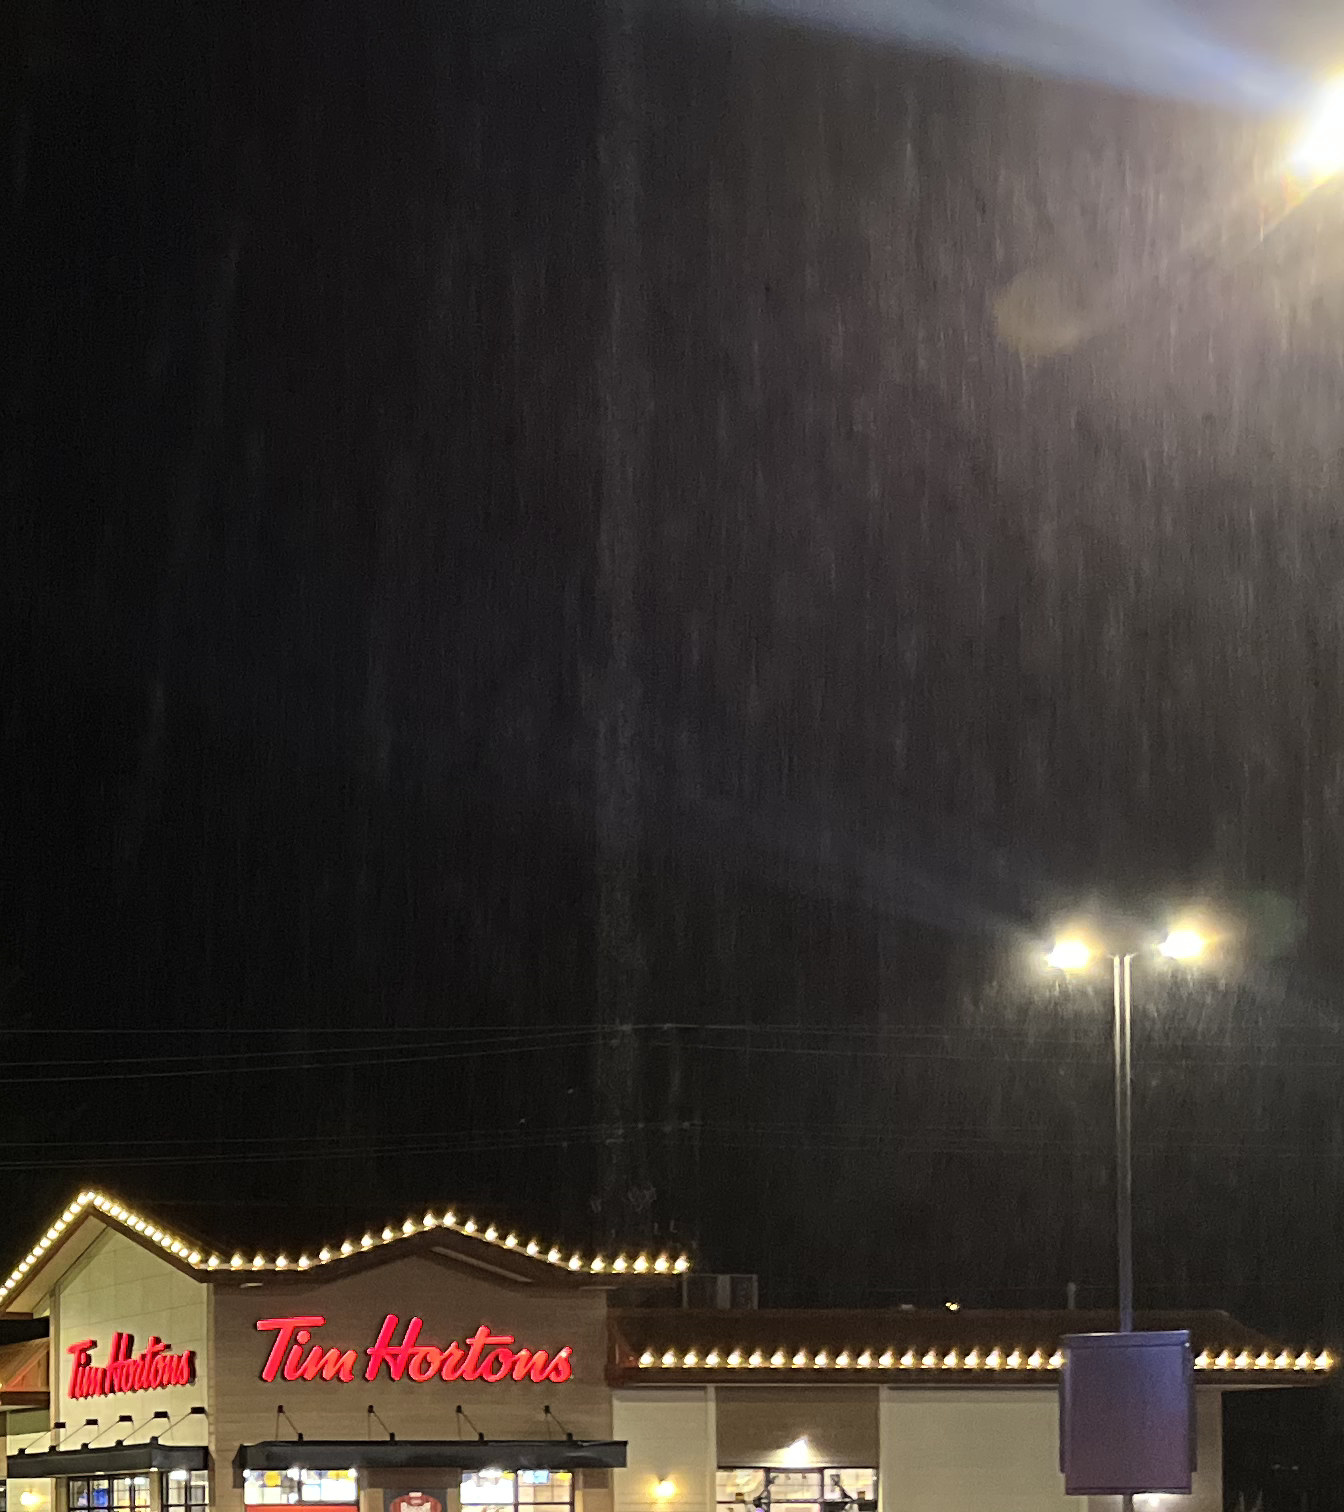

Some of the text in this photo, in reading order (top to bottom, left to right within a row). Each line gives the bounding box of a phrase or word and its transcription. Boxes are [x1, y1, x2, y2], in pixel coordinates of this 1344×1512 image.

[67, 1332, 196, 1400] Tim Hortons
[257, 1314, 573, 1383] Tim Hortons
